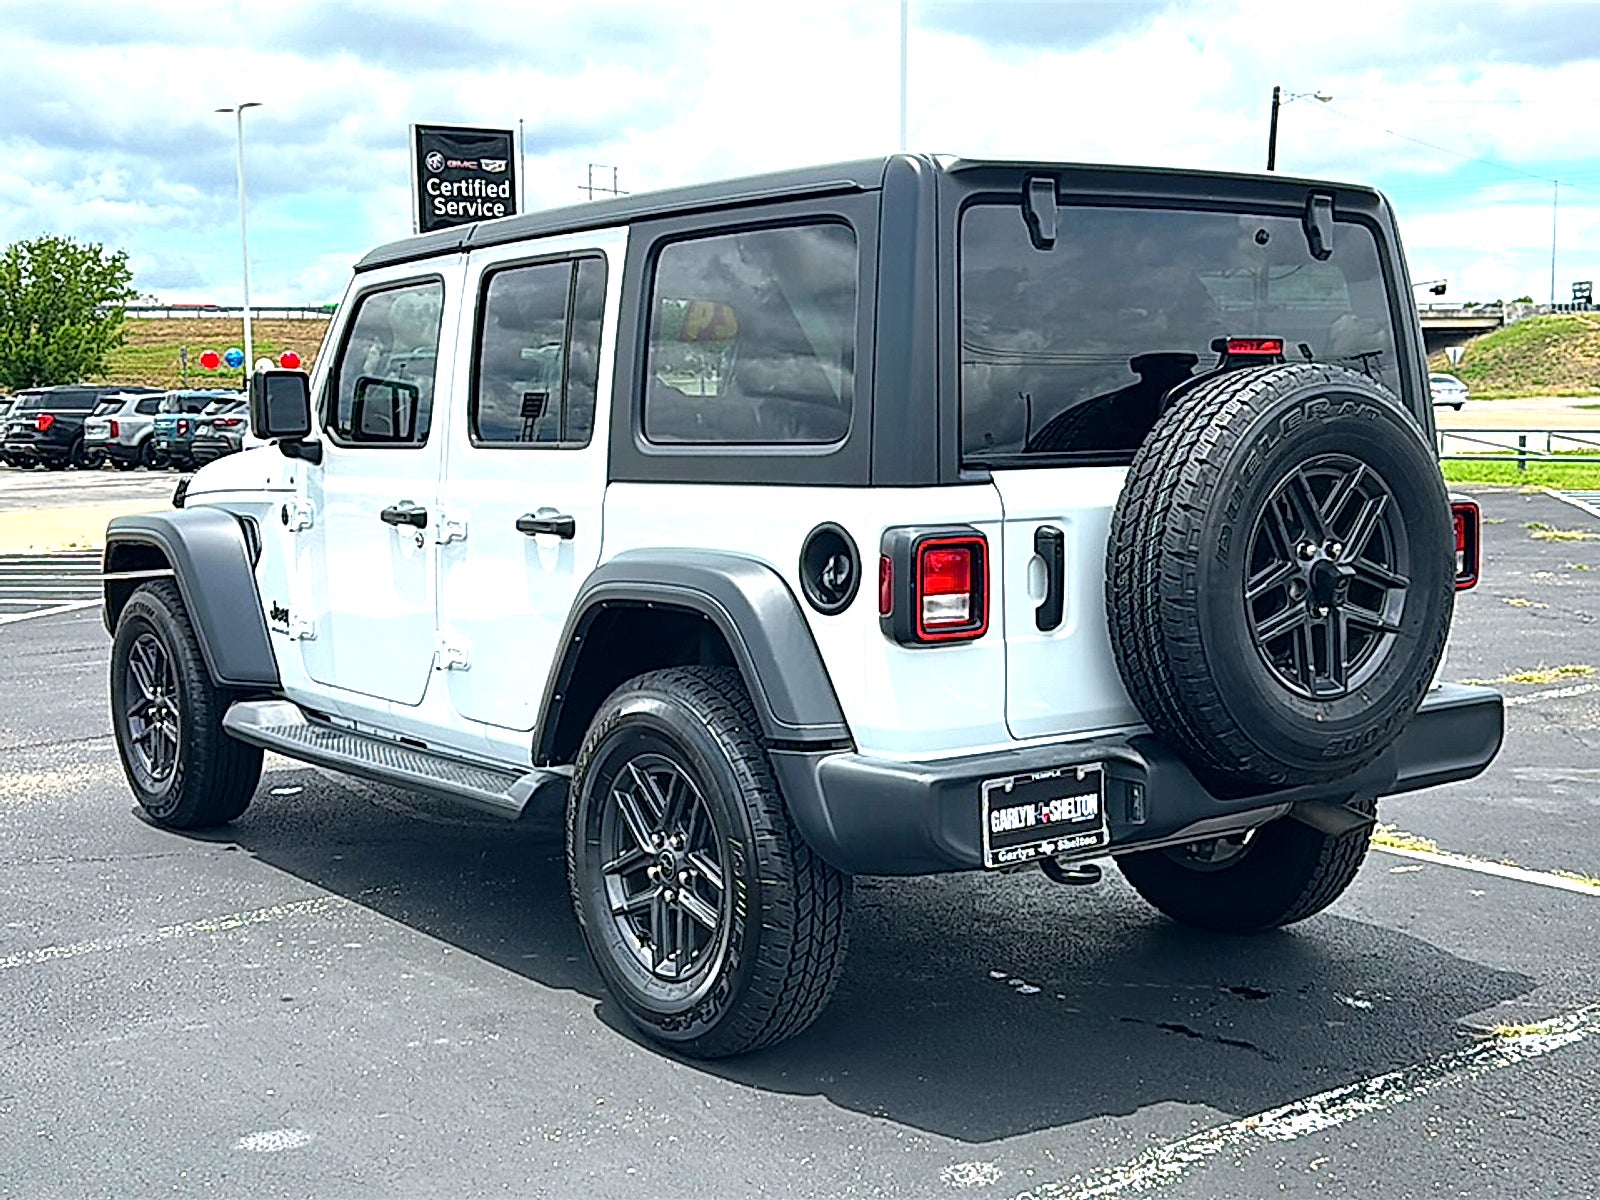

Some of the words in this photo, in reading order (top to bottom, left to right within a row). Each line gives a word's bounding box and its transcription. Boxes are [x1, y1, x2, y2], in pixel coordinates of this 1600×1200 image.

[446, 160, 479, 170] GMC
[426, 178, 510, 198] Certified
[434, 197, 505, 217] Service
[270, 600, 289, 628] Jeep
[991, 804, 1036, 833] GARLYN
[1049, 793, 1098, 822] SHELTON
